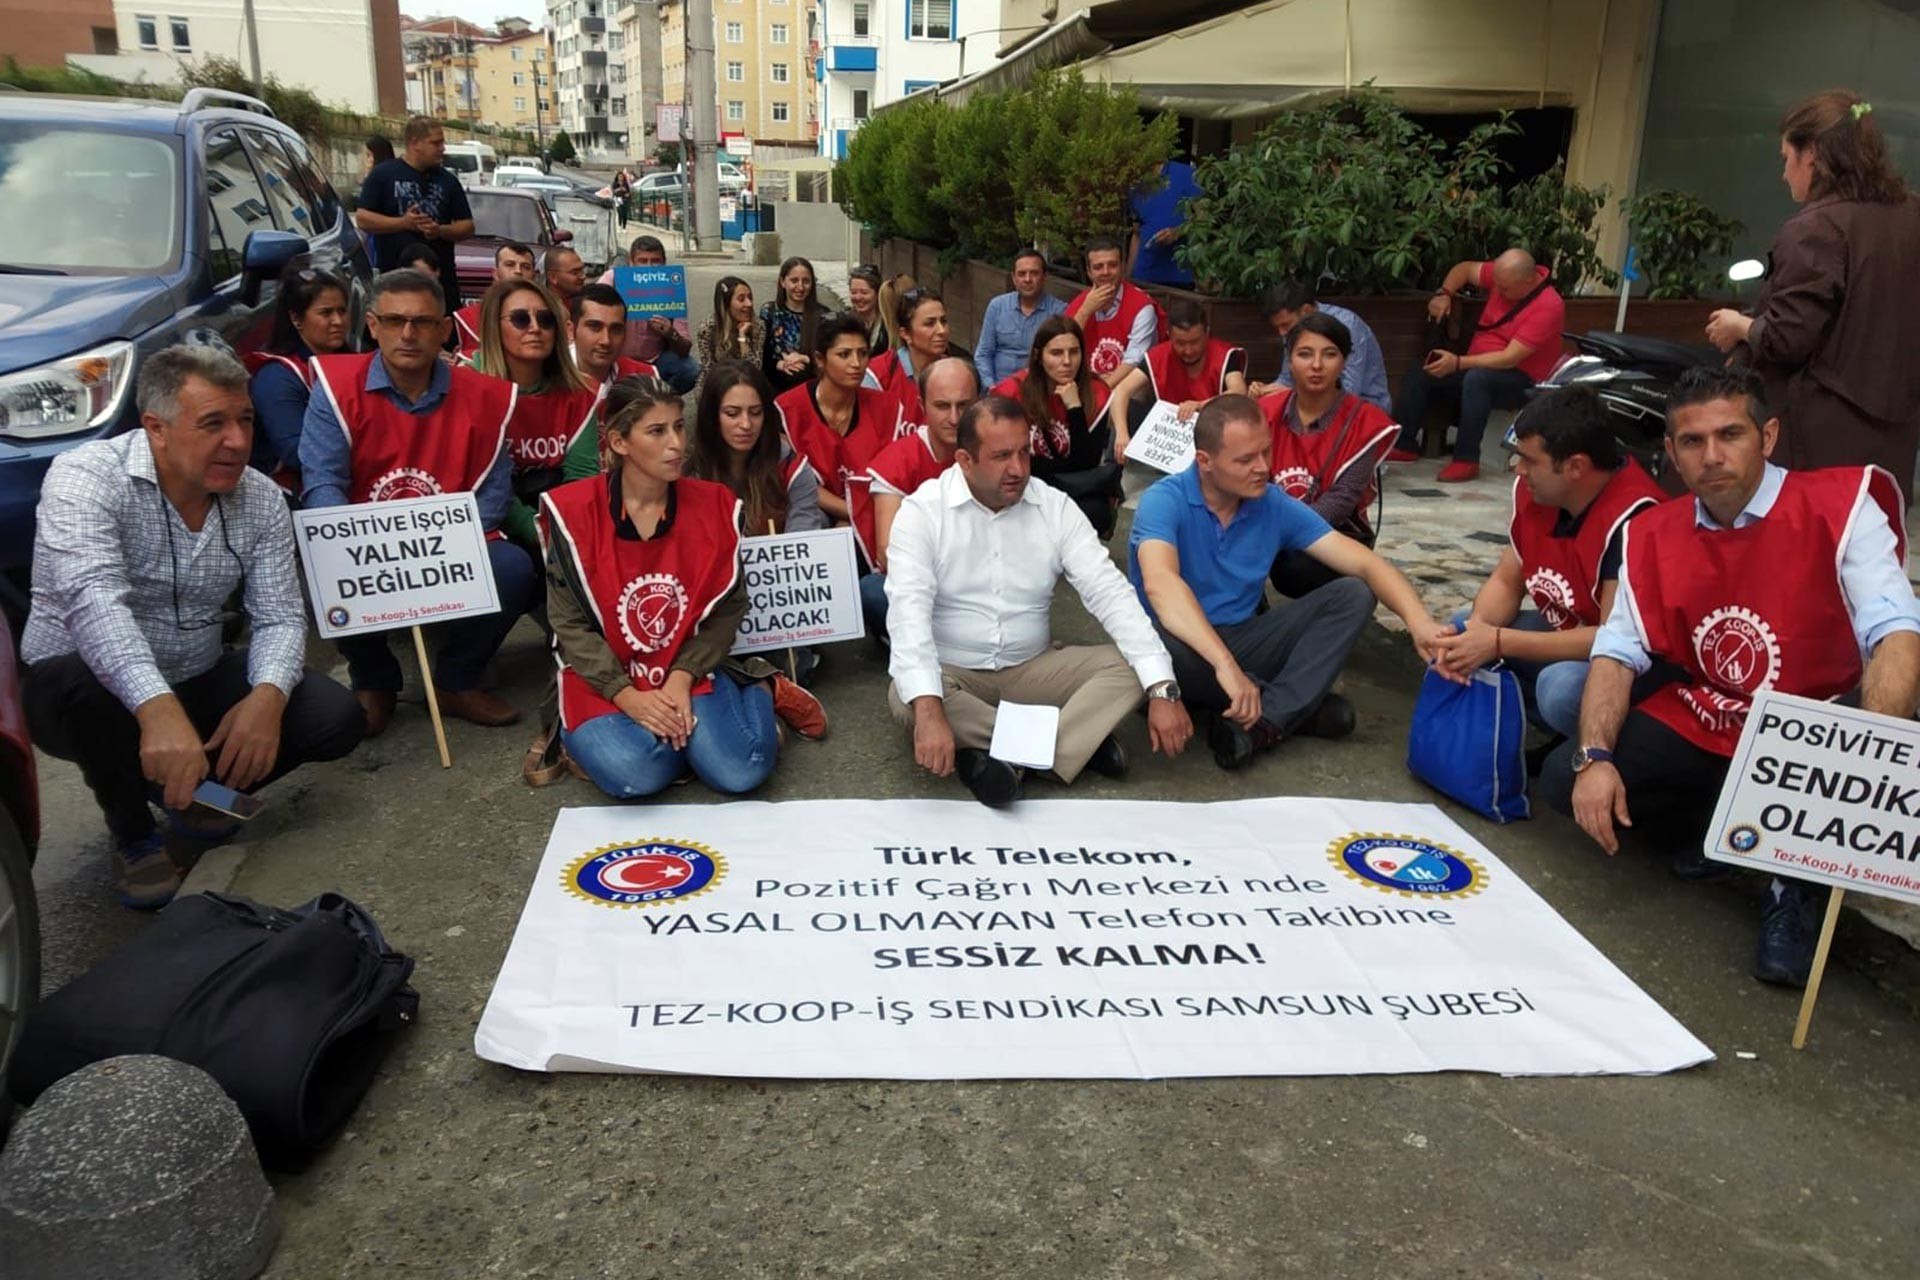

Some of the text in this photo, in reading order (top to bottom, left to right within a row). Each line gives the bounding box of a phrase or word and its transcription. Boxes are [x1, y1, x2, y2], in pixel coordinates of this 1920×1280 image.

[626, 301, 686, 312] AZANACAĞIZ
[505, 433, 567, 459] Z-KOOP
[1144, 446, 1174, 466] ZAFER
[306, 504, 472, 541] POSİTİVE İŞÇİSİ
[346, 536, 445, 566] YALNIZ
[742, 543, 810, 565] ZAFER
[337, 561, 475, 599] DEĞİLDİR!
[746, 562, 829, 587] OSİTİVE
[362, 603, 465, 624] Tez-Koop-İş Sendikası
[739, 608, 830, 635] OLACAK!
[1703, 629, 1720, 652] TEZ
[1727, 661, 1743, 680] tk
[1759, 713, 1914, 766] POSİVİTE
[874, 846, 1192, 867] Türk Telekom,
[1774, 848, 1858, 879] Tez-Koop-İş
[1408, 867, 1438, 881] tk
[610, 890, 676, 903] 1952
[756, 875, 1329, 901] Pozitif Çağrı Merkezi nde
[643, 904, 1456, 935] YASAL OLMAYAN Telefon Takibine
[874, 942, 1266, 969] SESSİZ KALMA!
[621, 987, 1536, 1027] TEZ-KOOP-İŞ SENDİKASI SAMSUN ŞUBESİ
